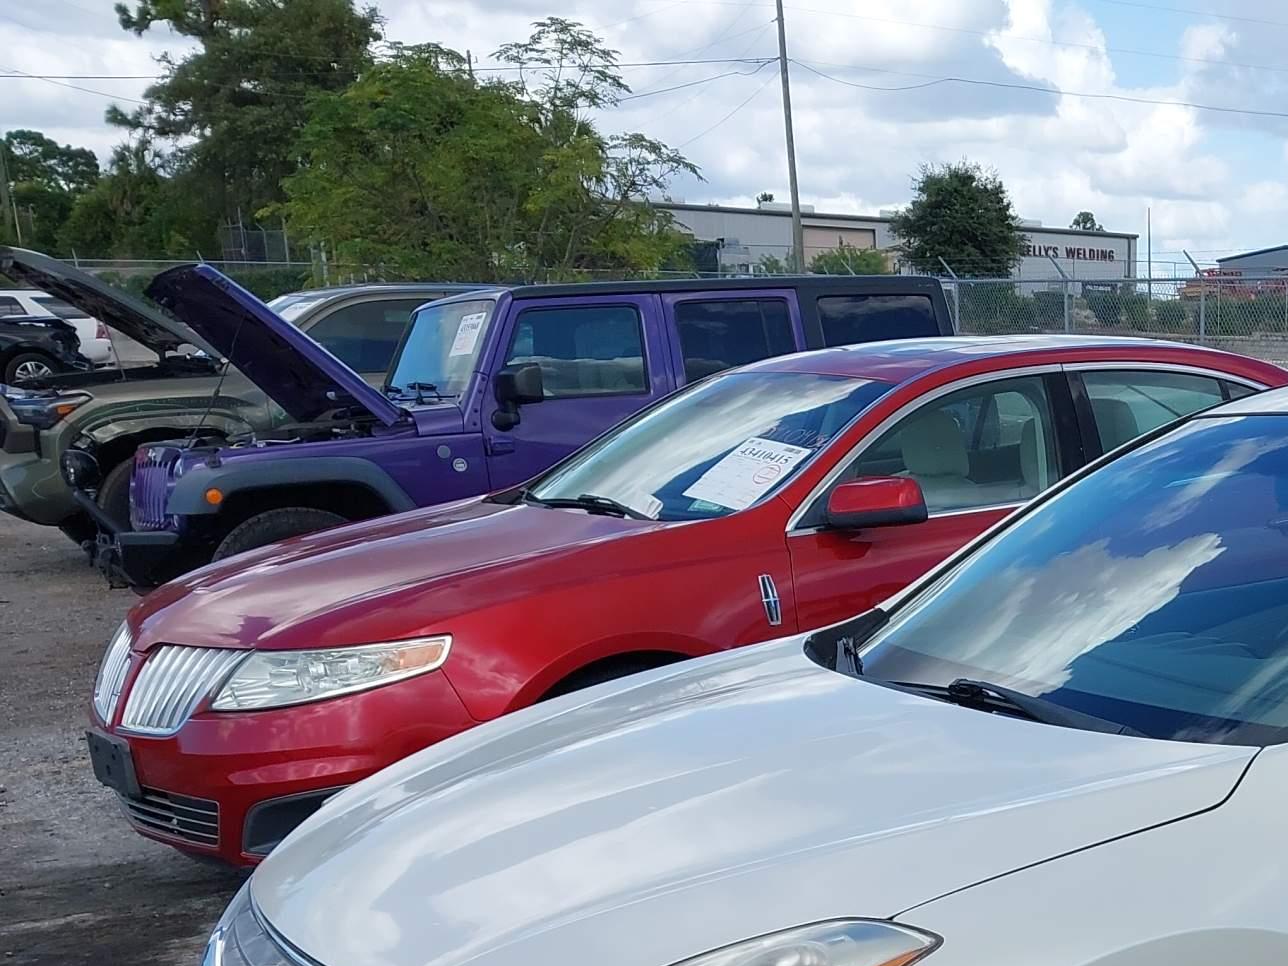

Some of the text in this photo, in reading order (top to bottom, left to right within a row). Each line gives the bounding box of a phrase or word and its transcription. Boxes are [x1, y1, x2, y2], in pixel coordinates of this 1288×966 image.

[1024, 243, 1115, 262] ELLY'S WELDING
[739, 447, 793, 464] 43410415
